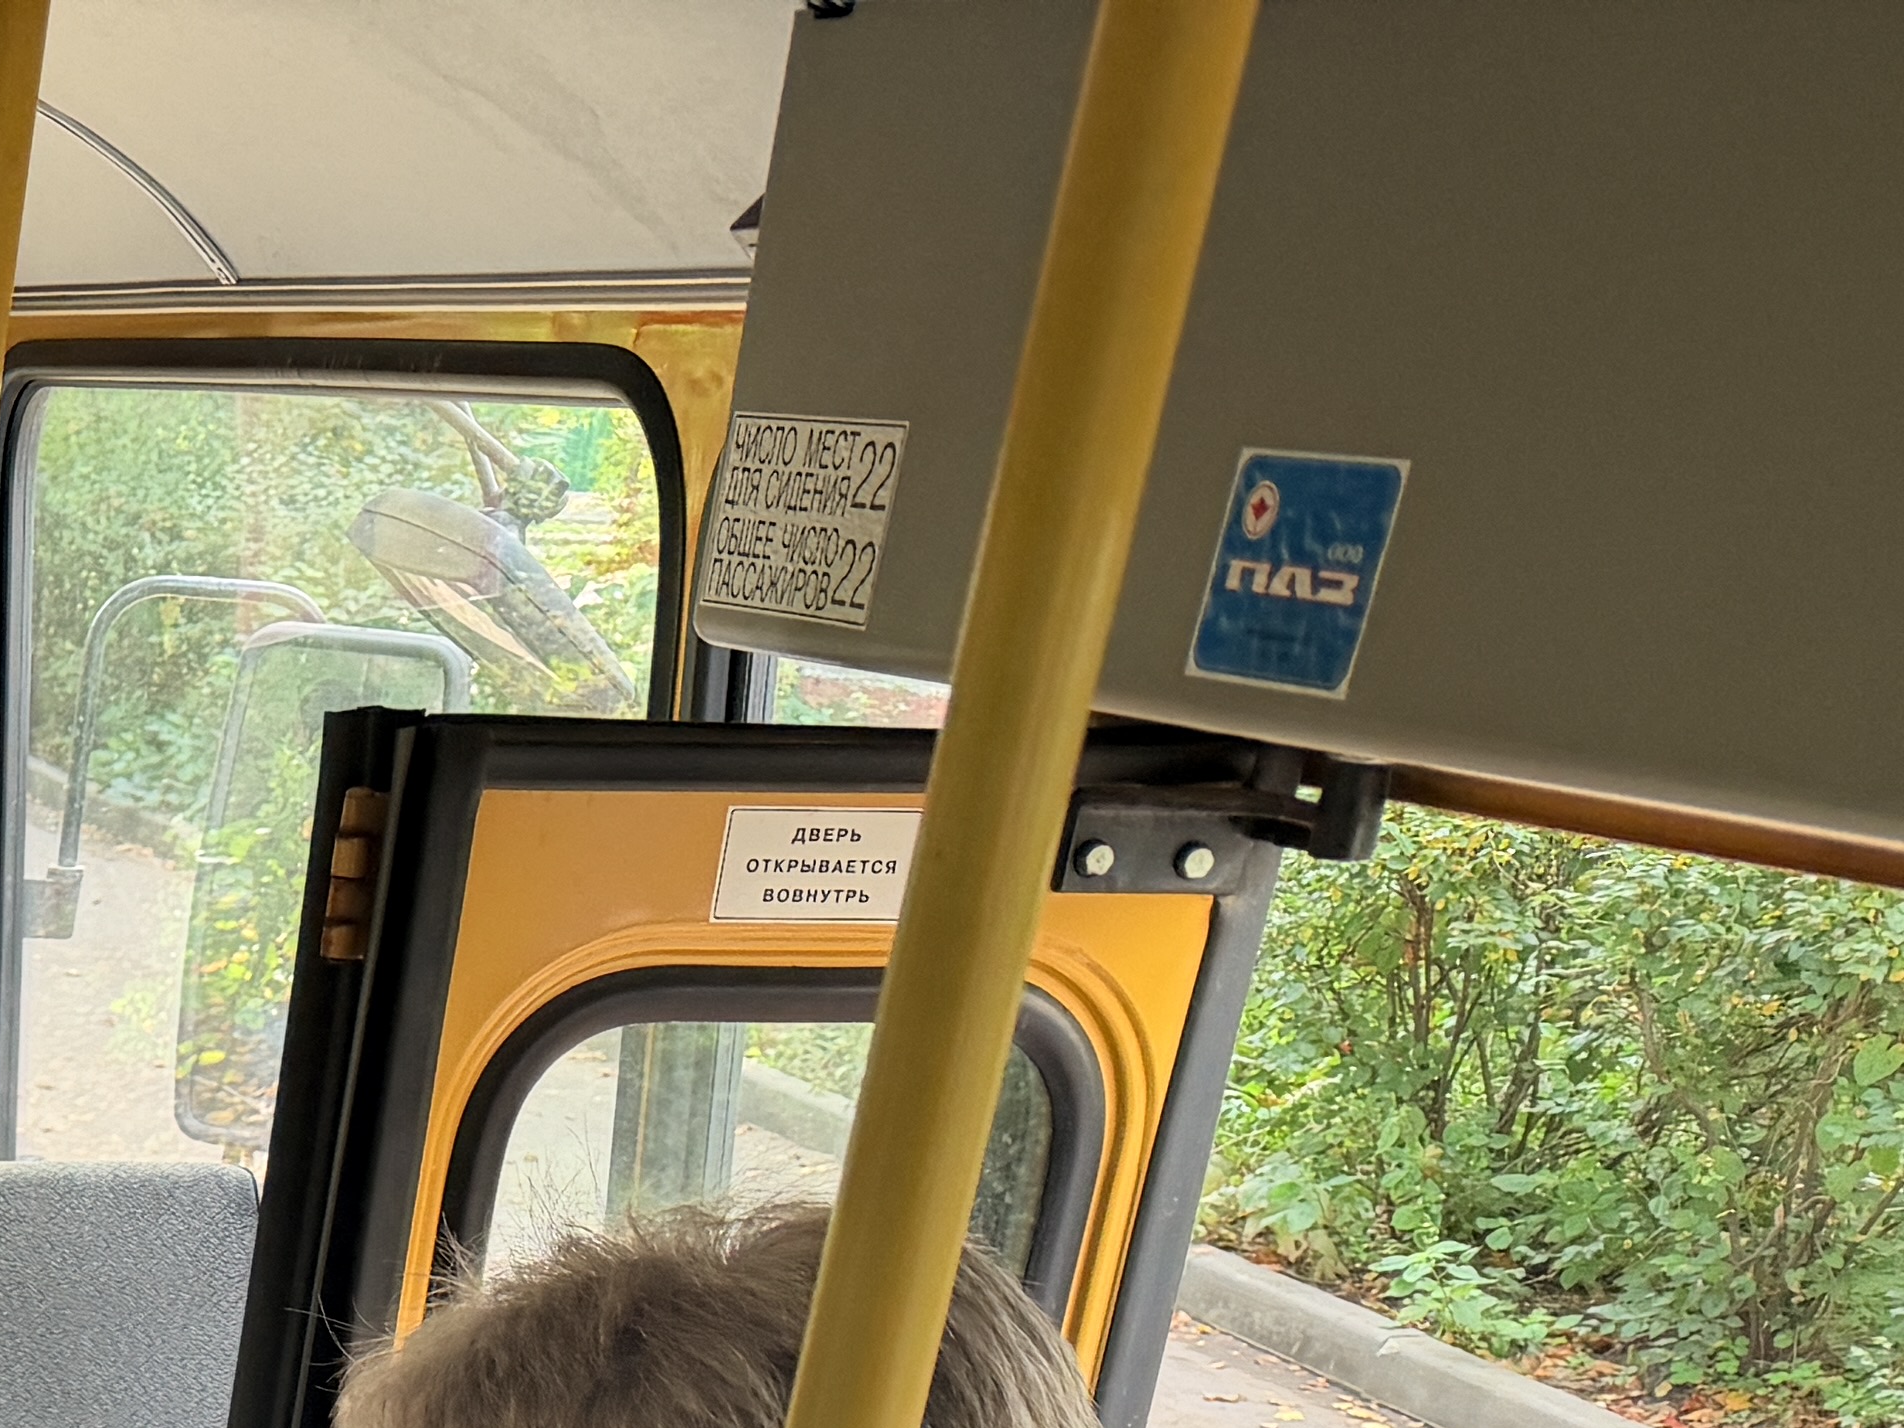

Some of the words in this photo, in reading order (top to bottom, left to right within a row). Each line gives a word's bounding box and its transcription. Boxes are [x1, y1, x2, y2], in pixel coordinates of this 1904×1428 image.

[735, 422, 798, 465] ЧИСЛО
[802, 428, 861, 470] МЕСТ
[725, 466, 763, 509] ДЛЯ
[765, 469, 852, 517] СИДЕНИЯ
[850, 440, 898, 511] 22
[715, 515, 777, 561] ОБЩЕЕ
[781, 522, 842, 568] ЧИСЛО
[706, 558, 832, 611] ПАССАЖИРОВ
[830, 538, 877, 610] 22
[1224, 557, 1361, 607] ПАЗ
[790, 825, 863, 846] ДВЕРЬ
[745, 856, 898, 877] ОТКРЫВАЕТСЯ
[761, 886, 871, 906] ВОВНУТРЬ
